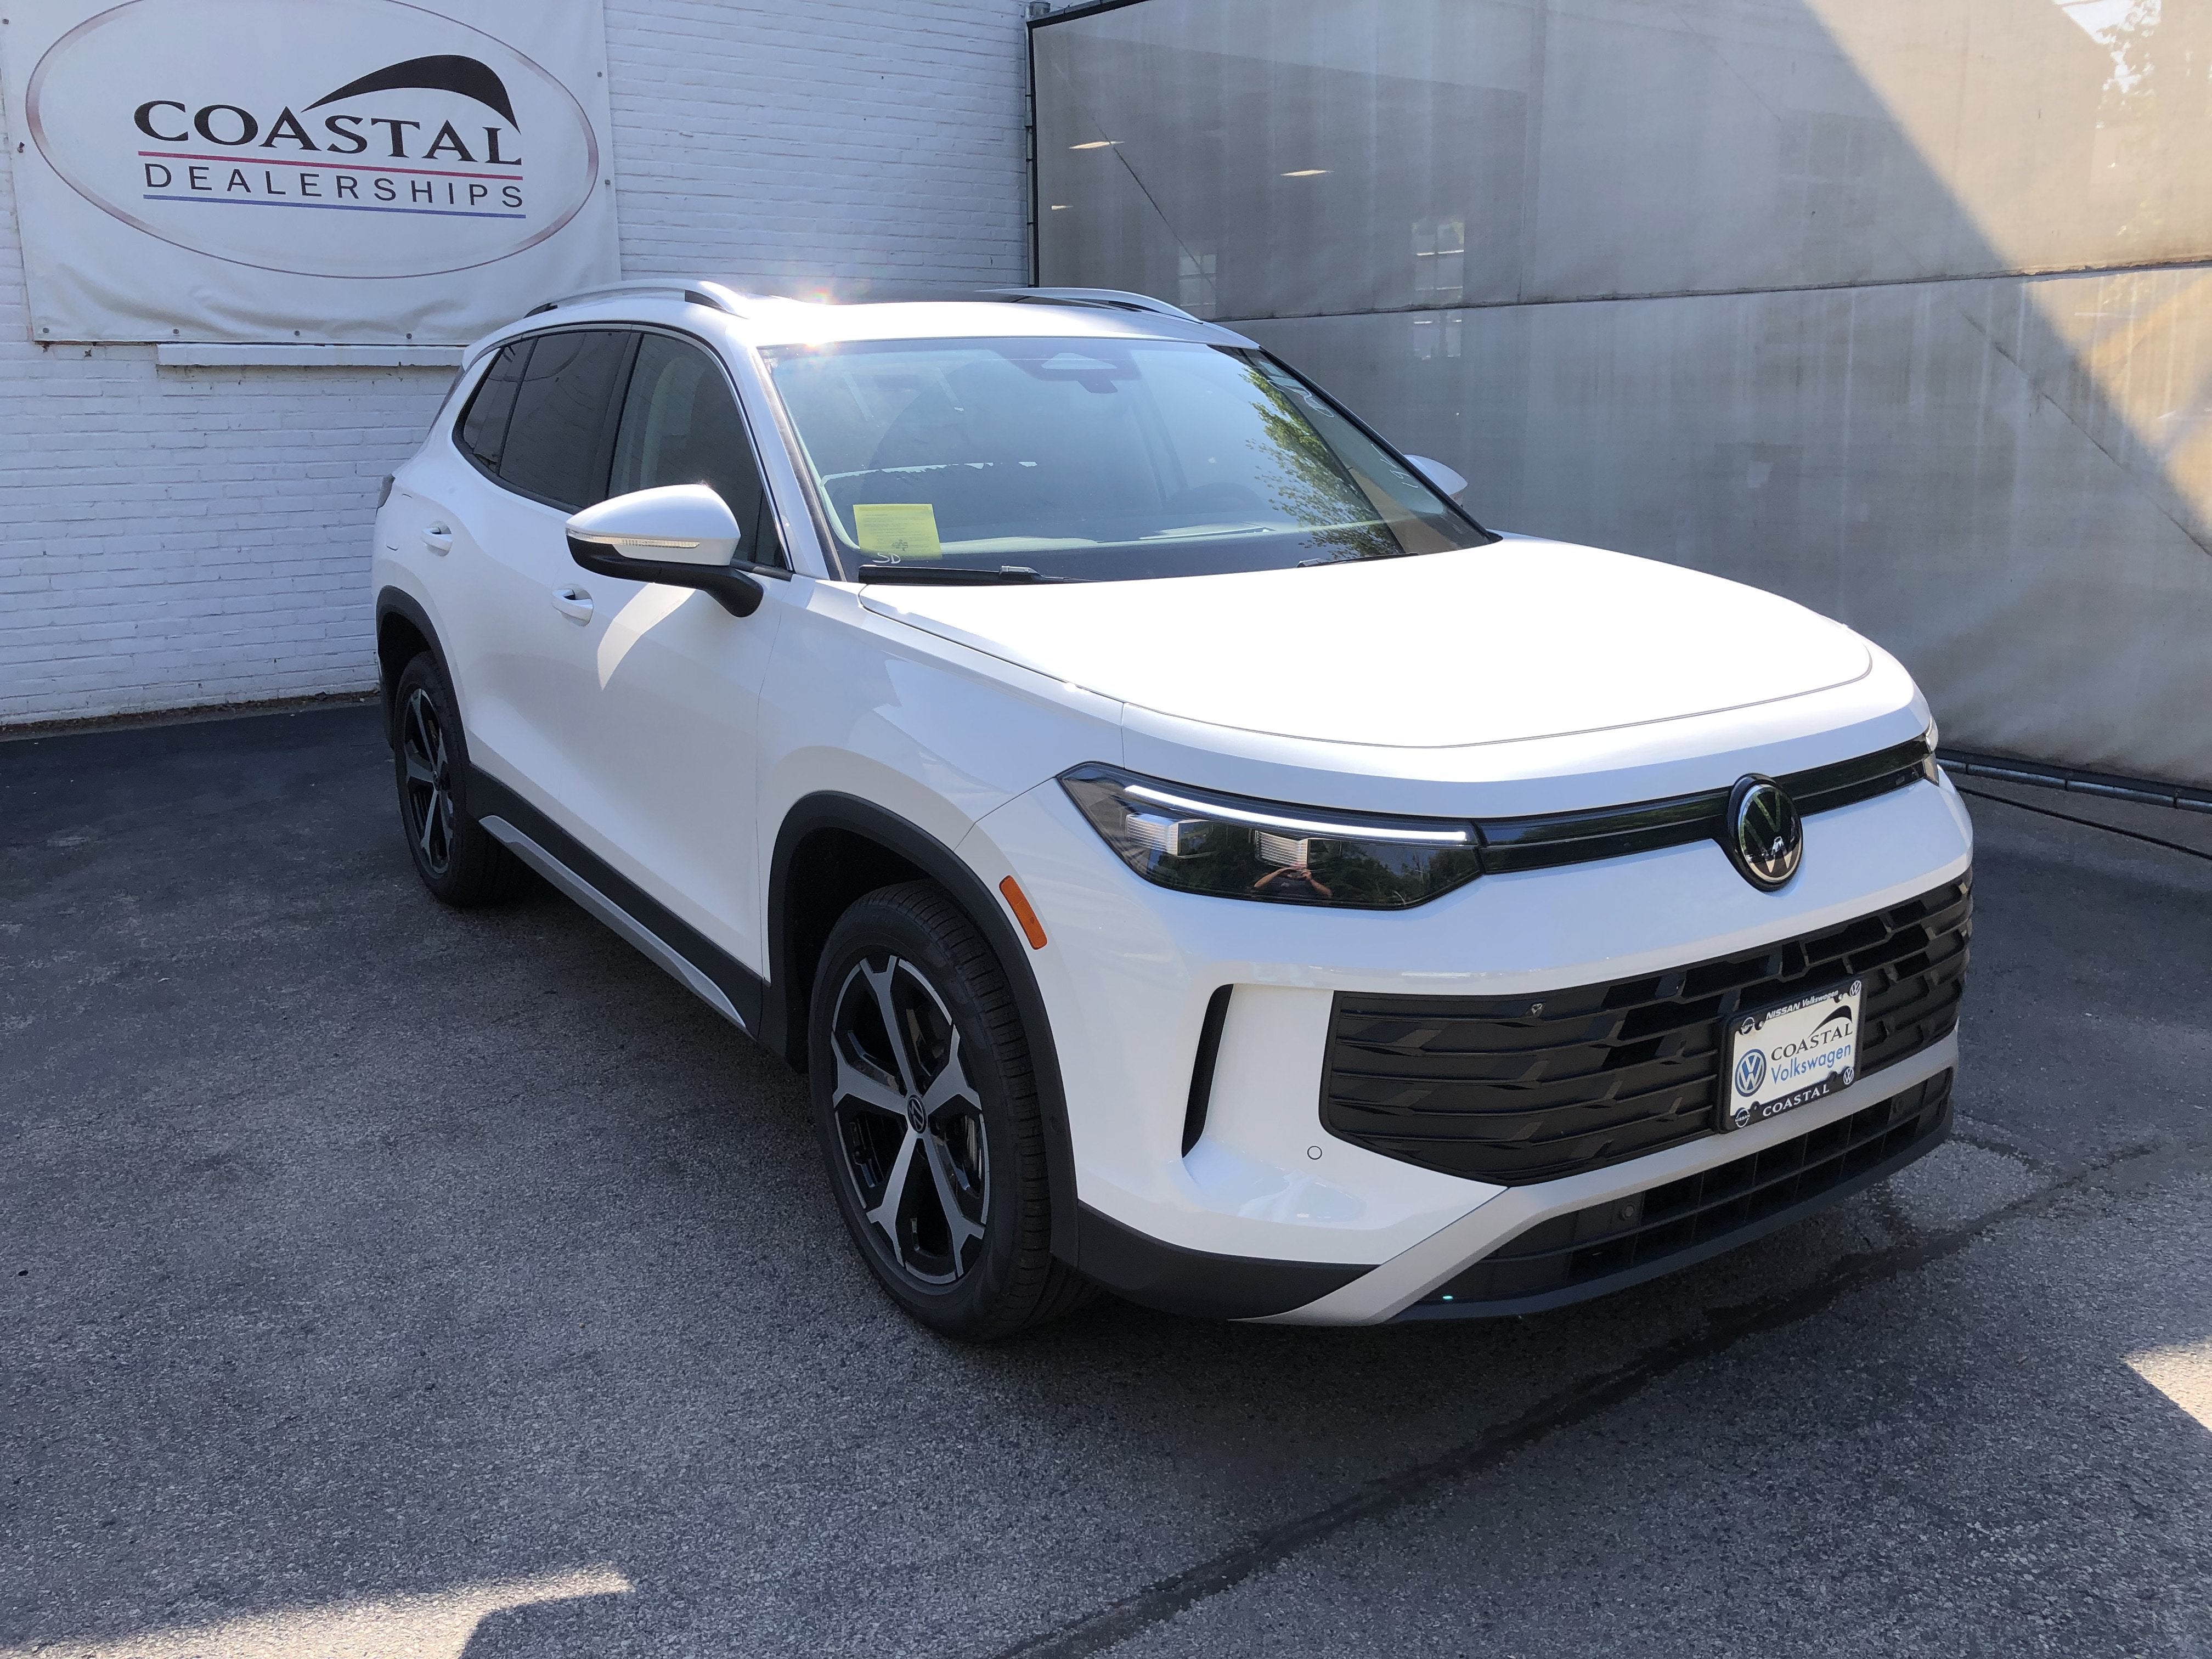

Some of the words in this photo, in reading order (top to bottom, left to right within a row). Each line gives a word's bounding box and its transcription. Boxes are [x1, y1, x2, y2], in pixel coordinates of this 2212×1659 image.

[134, 100, 522, 165] COASTAL
[144, 163, 523, 207] DEALERSHIPS
[1766, 1001, 1800, 1020] NISSAN
[1802, 990, 1838, 1007] Volkswagen
[1771, 1023, 1853, 1060] COASTAL
[1771, 1044, 1851, 1084] Volkswagen
[1762, 1084, 1829, 1117] COASTAL
